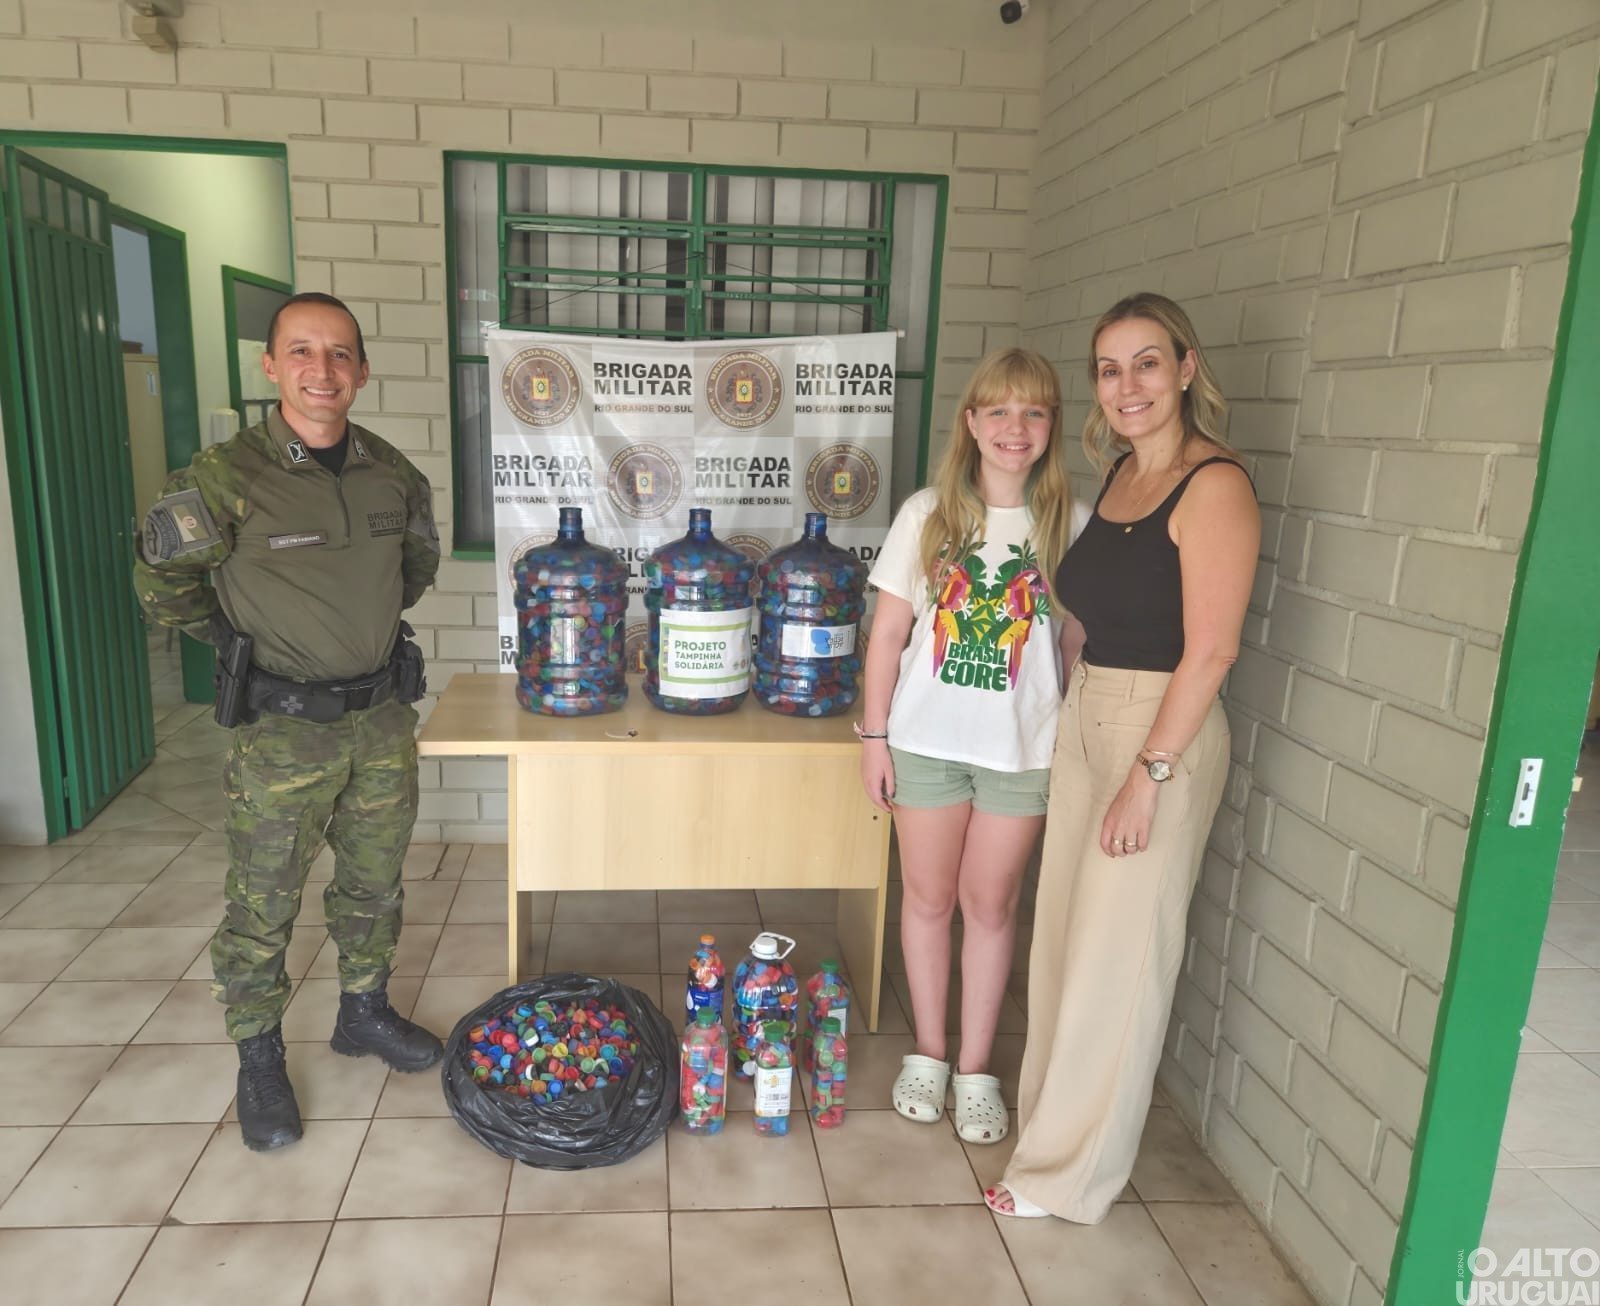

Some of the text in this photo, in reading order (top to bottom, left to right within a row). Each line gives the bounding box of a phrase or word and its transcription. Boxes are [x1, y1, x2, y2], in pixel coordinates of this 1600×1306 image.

[593, 362, 693, 379] BRIGADA
[795, 363, 894, 379] BRIGADA
[593, 380, 693, 396] MILITAR
[795, 380, 893, 396] MILITAR
[594, 403, 693, 413] RIO GRANDE DO SUL
[795, 405, 893, 413] RIO GRANDE DO SUL
[493, 454, 593, 470] BRIGADA
[695, 456, 791, 472] BRIGADA
[494, 471, 593, 487] MILITAR
[695, 473, 791, 488] MILITAR
[495, 495, 513, 504] RIO
[557, 496, 572, 504] DO
[695, 497, 792, 505] RIO GRANDE DO SUL
[674, 640, 727, 651] PROJETO
[947, 642, 1007, 665] BRASIL
[675, 652, 722, 660] TAMPINHA
[940, 659, 1008, 692] CORE
